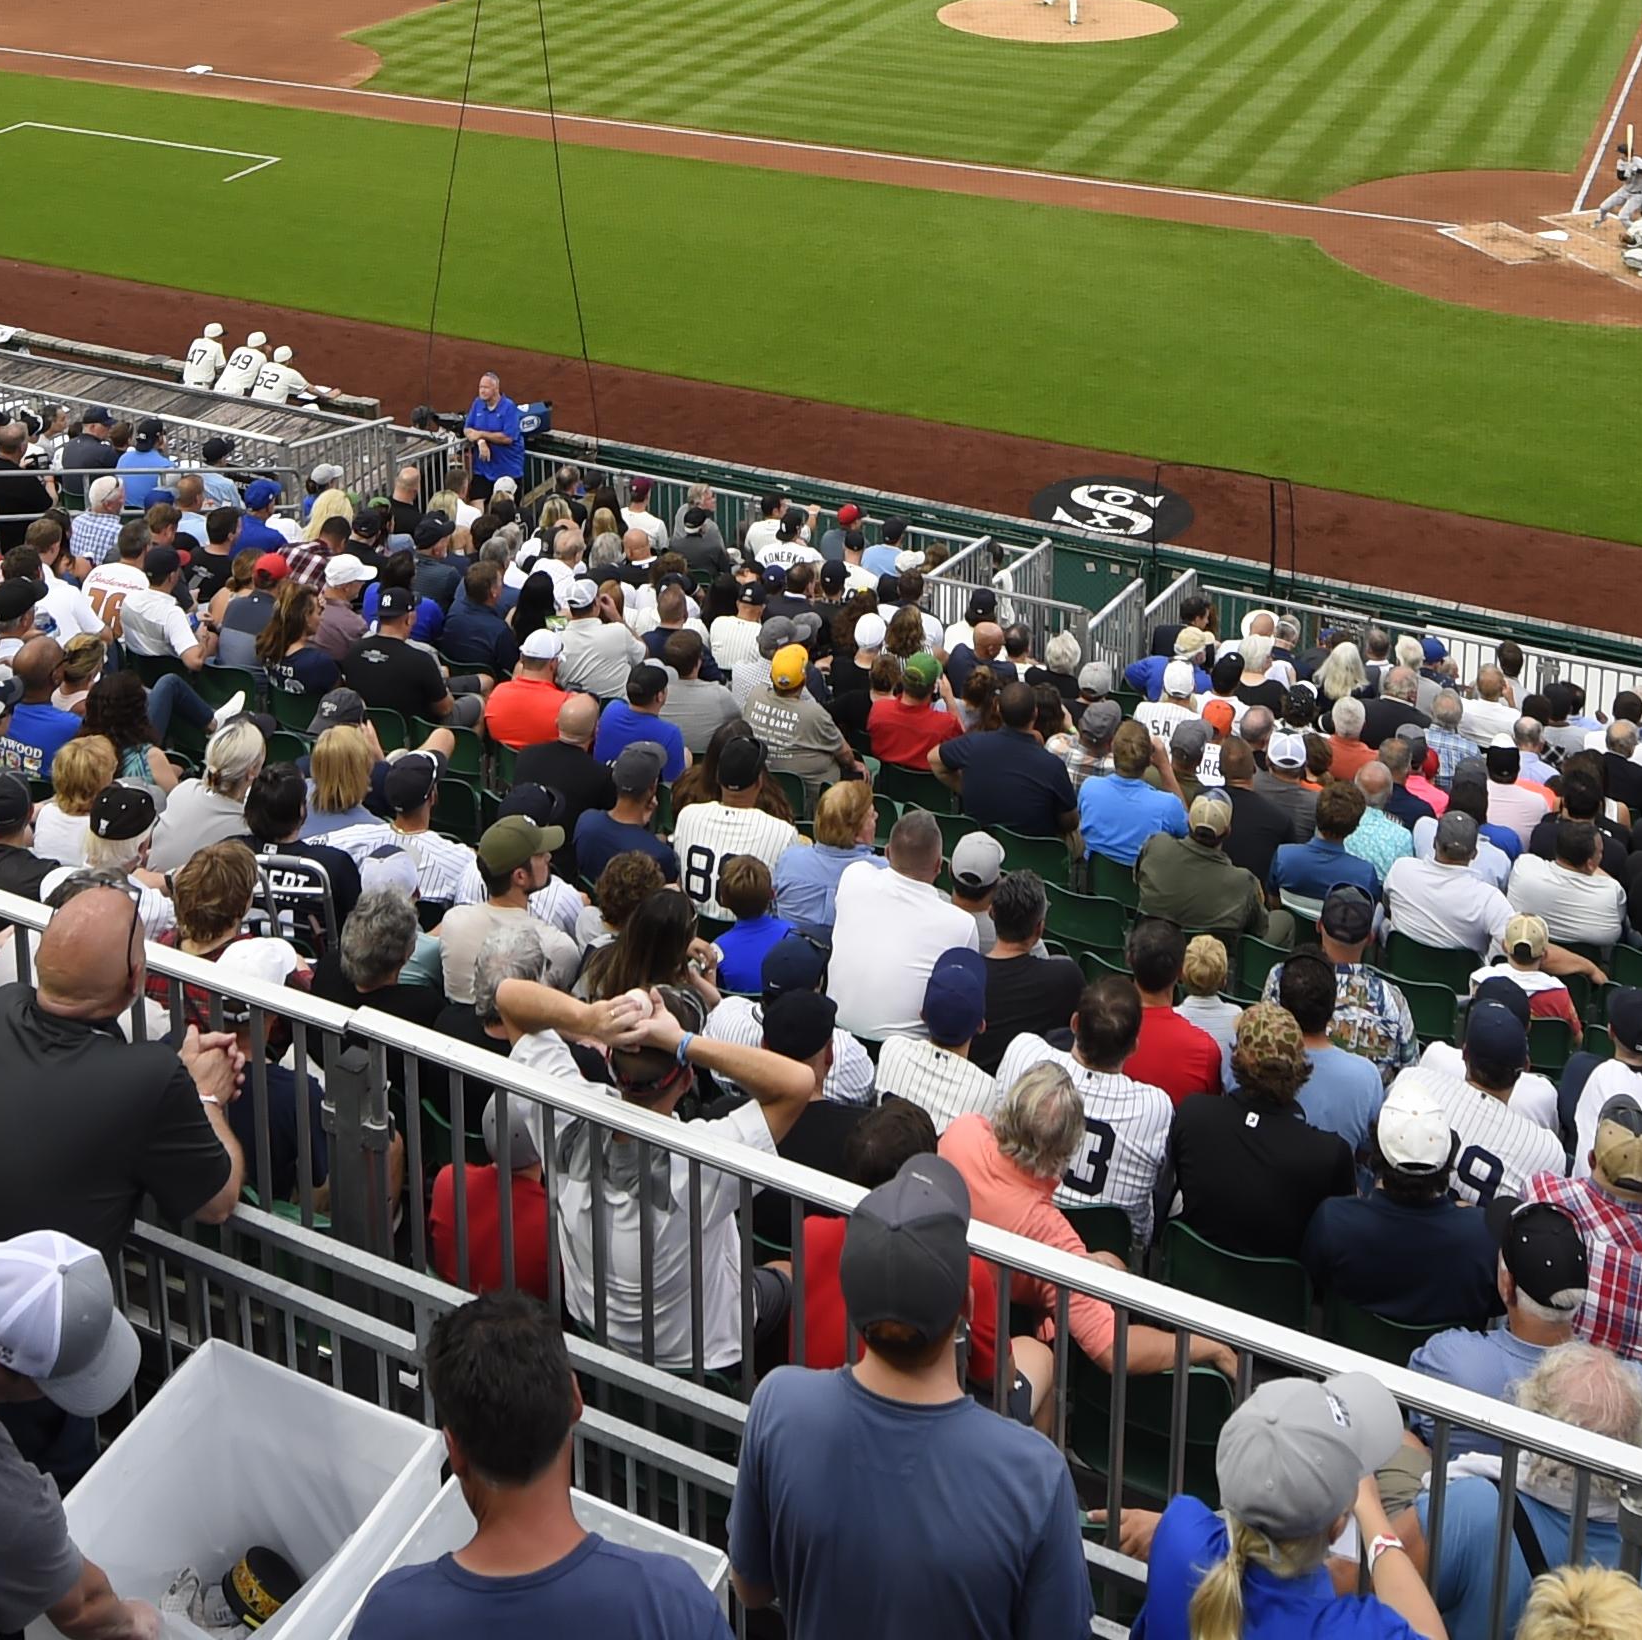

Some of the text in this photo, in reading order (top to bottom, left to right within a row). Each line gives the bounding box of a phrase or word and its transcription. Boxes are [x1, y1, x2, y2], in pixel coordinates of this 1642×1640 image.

[188, 348, 207, 366] 47
[230, 353, 253, 371] 49
[753, 701, 771, 714] THIS
[750, 711, 768, 725] THIS
[1151, 719, 1171, 737] SA
